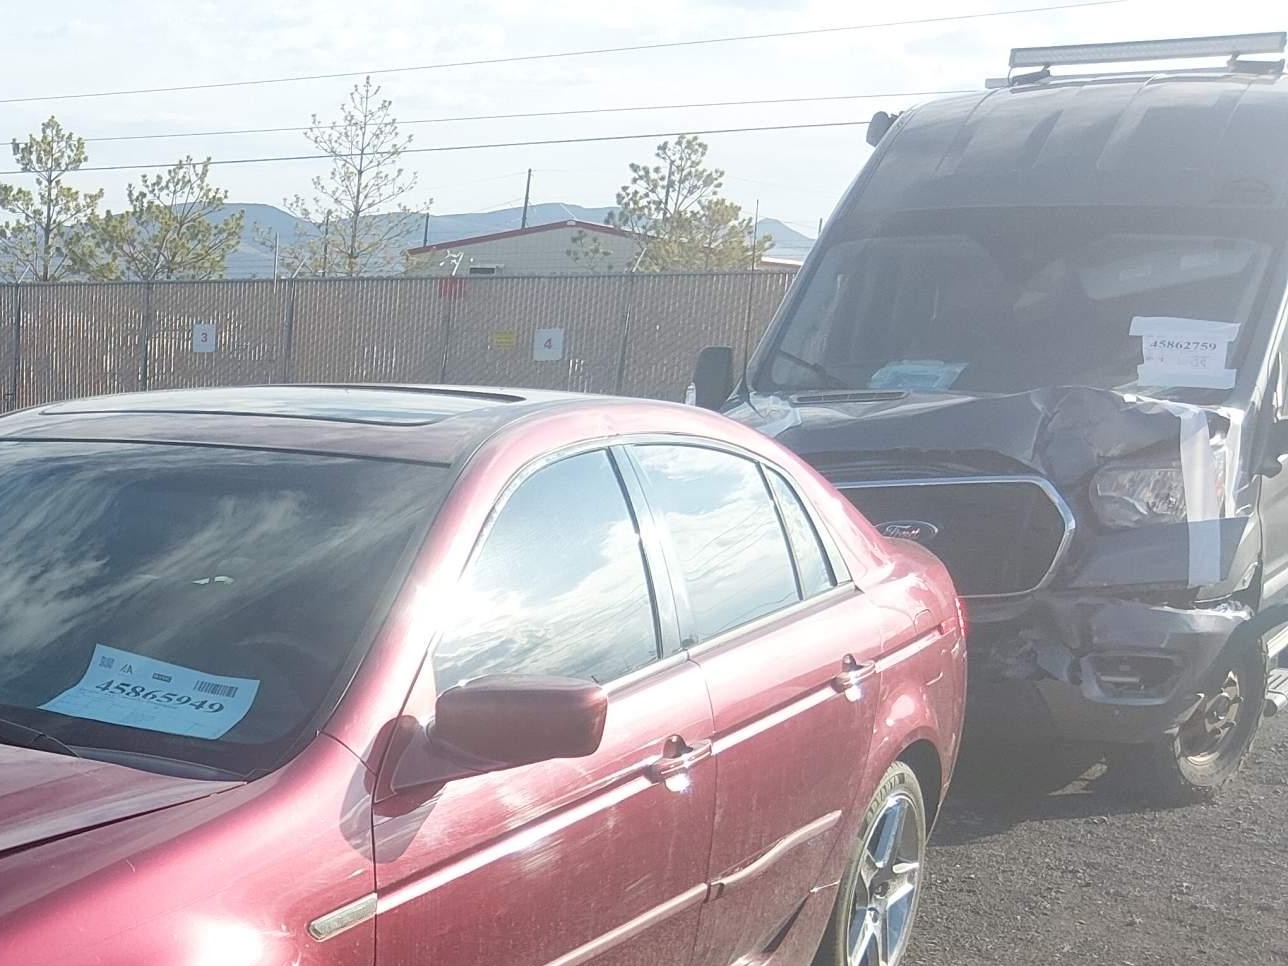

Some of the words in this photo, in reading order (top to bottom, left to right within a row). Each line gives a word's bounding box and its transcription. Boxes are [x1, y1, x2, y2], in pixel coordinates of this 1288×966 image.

[200, 333, 209, 343] 3
[544, 338, 552, 349] 4
[1150, 340, 1217, 351] 45862759
[95, 680, 225, 713] 45865949
